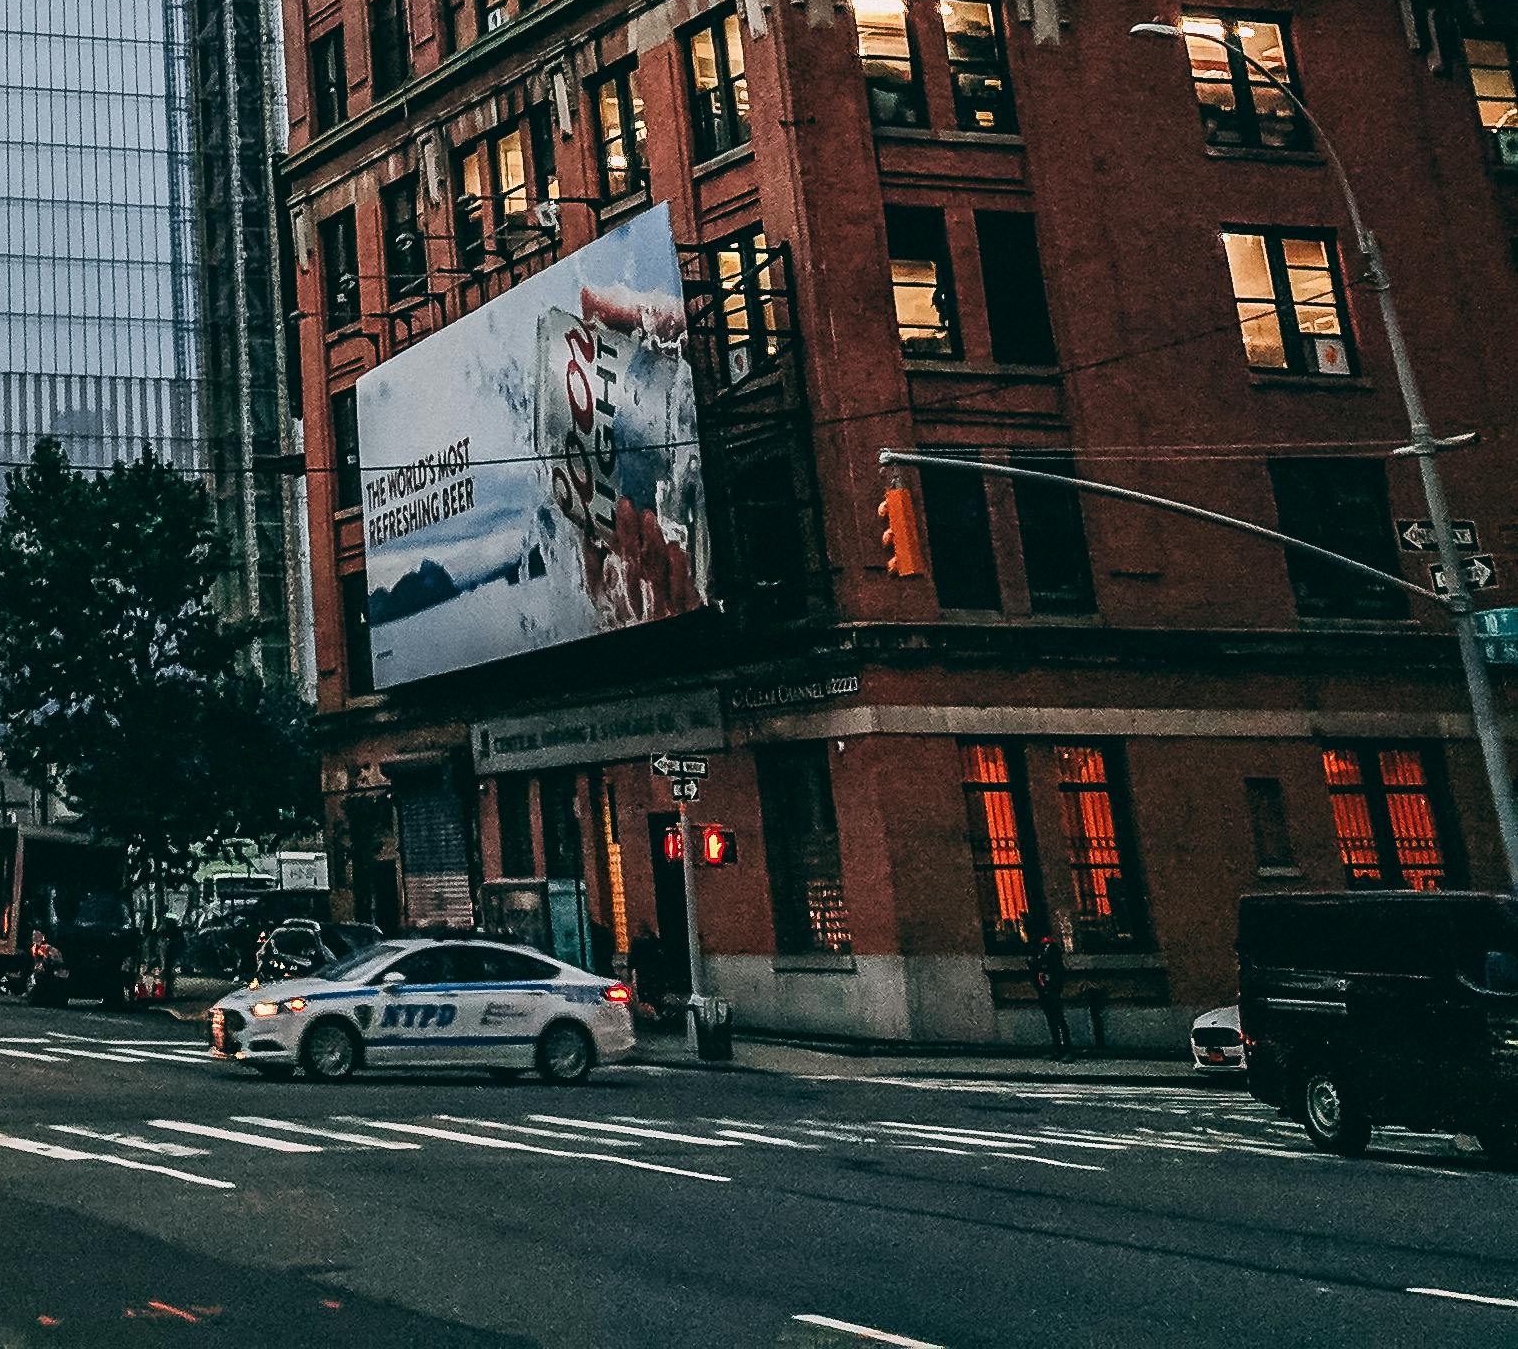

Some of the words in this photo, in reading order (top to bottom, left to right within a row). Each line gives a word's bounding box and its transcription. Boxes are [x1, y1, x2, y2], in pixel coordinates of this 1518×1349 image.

[551, 319, 596, 537] Coor
[594, 334, 618, 532] LIGHT
[366, 476, 386, 513] THE
[387, 454, 436, 500] WORLD'S
[437, 436, 470, 481] MOST
[369, 492, 440, 547] REFRESHING
[442, 476, 475, 519] BEER
[382, 1002, 458, 1029] NYPD
